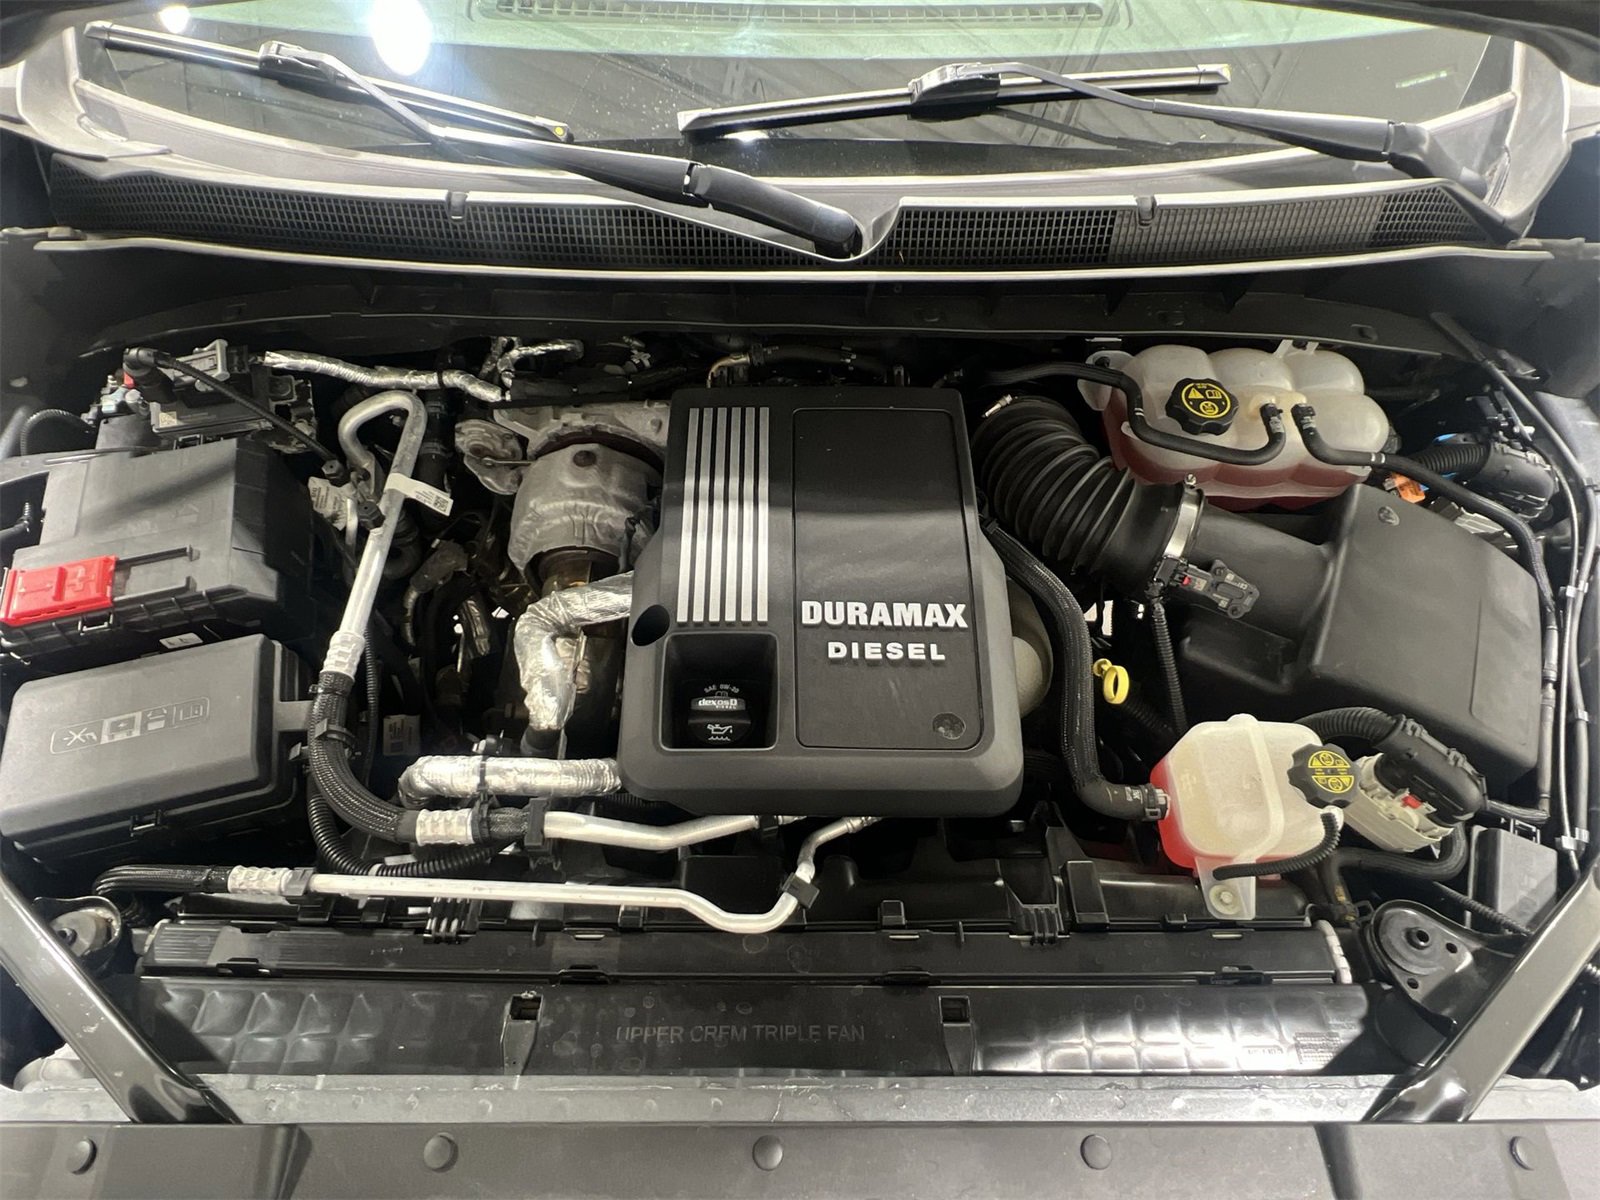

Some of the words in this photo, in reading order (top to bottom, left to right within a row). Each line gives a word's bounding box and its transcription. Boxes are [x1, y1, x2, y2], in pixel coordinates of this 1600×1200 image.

[801, 600, 968, 628] DURAMAX
[827, 641, 946, 660] DIESEL
[615, 1025, 685, 1043] UPPER
[751, 1024, 822, 1042] TRIPLE
[827, 1024, 865, 1042] FAN
